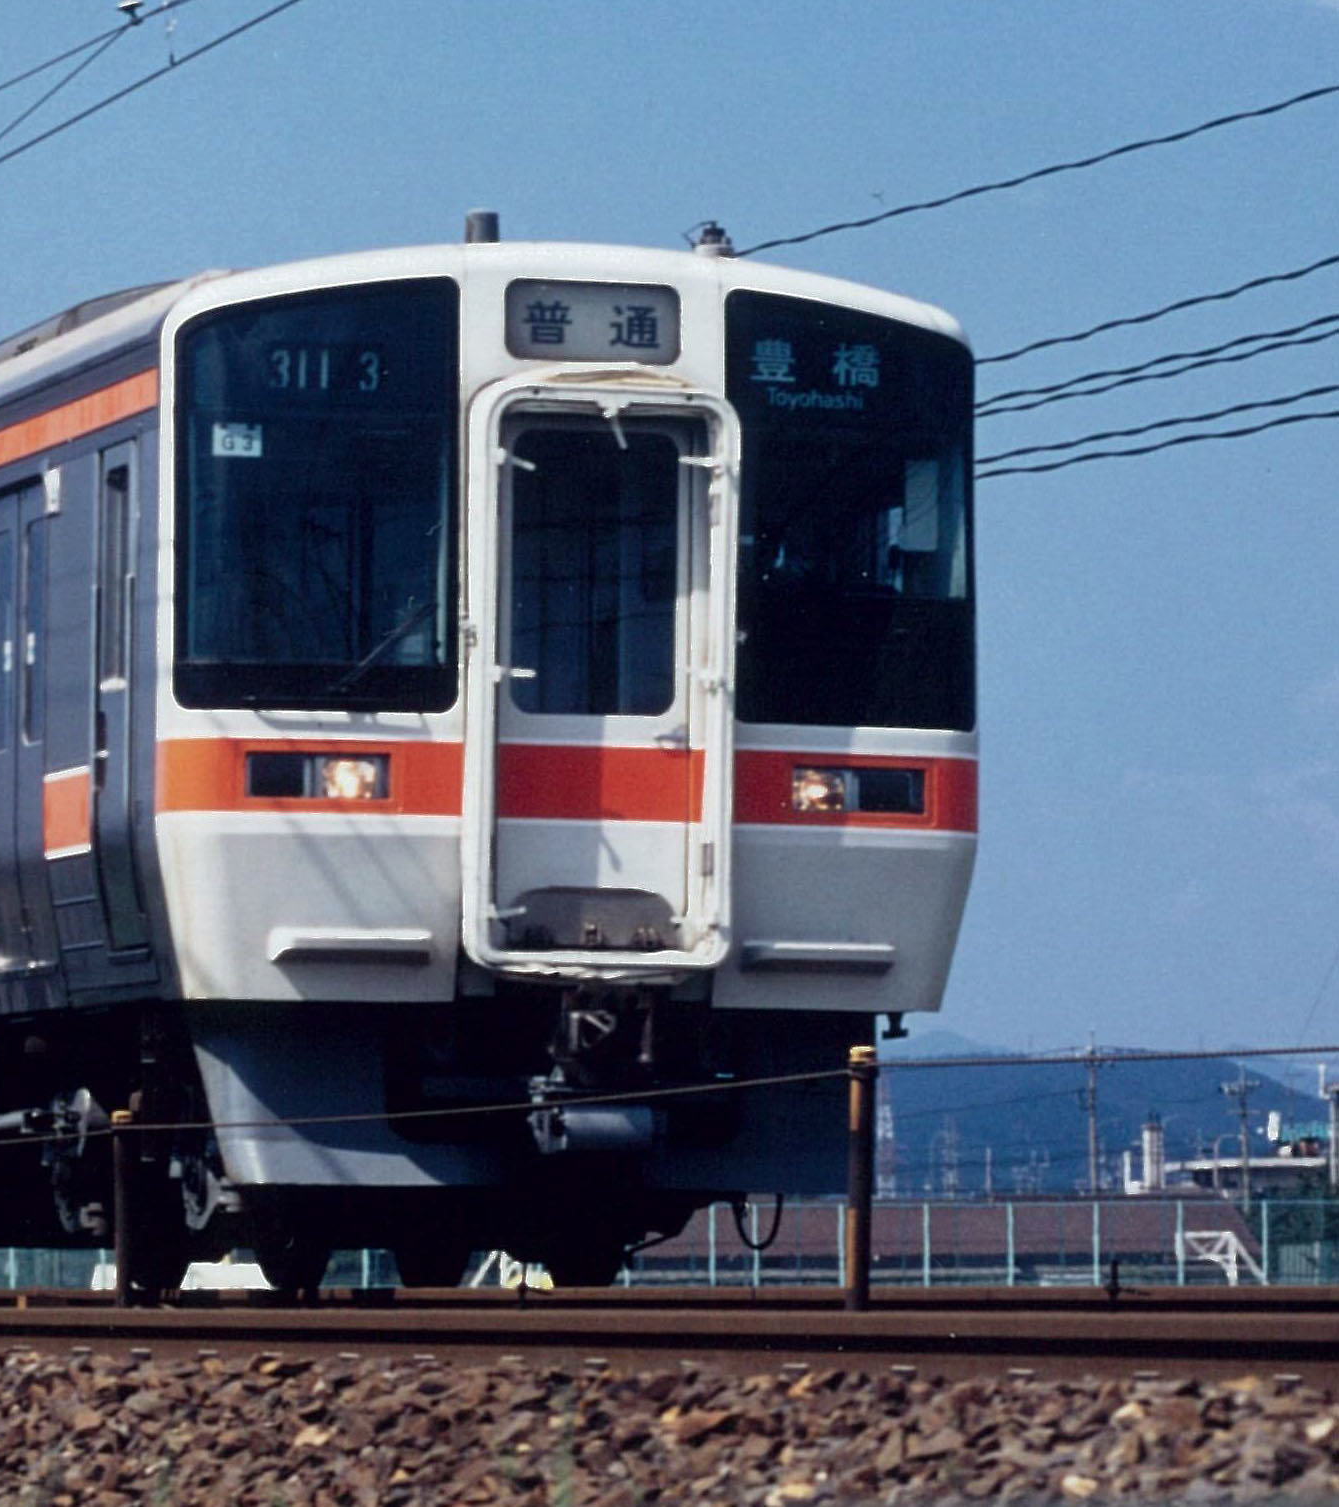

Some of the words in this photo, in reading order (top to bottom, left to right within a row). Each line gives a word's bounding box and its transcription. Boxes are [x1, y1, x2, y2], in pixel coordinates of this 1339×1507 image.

[523, 300, 660, 349] 普通
[269, 349, 330, 389] 311
[358, 350, 380, 391] 3
[750, 339, 880, 386] 豊橋
[767, 386, 864, 411] Toyohashi
